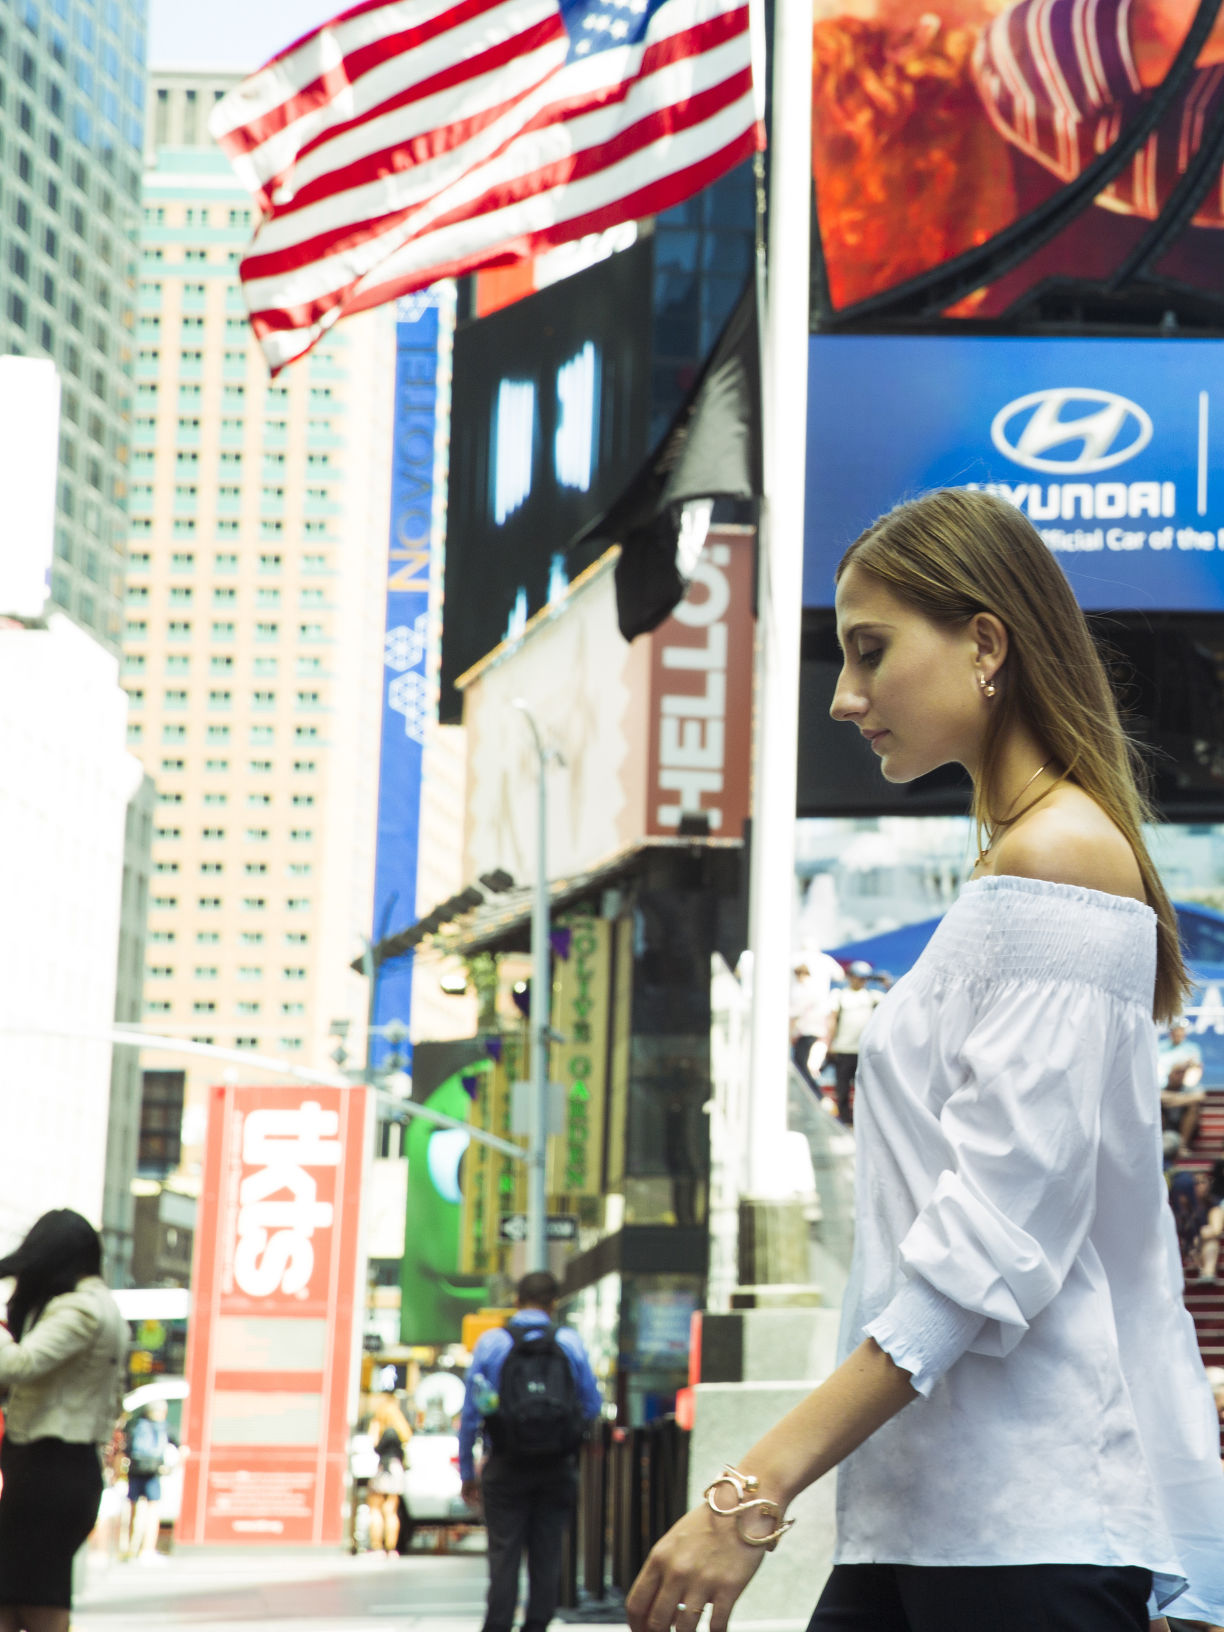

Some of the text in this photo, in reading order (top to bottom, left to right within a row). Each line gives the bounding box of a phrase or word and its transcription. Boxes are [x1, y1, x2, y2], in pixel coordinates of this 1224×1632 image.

[387, 323, 437, 592] NOVOTEL
[966, 481, 1176, 521] YUNDAI
[1037, 527, 1104, 552] fficial
[1106, 527, 1146, 551] Car
[1148, 525, 1174, 551] of
[1176, 526, 1215, 552] the
[233, 1100, 343, 1297] tkts
